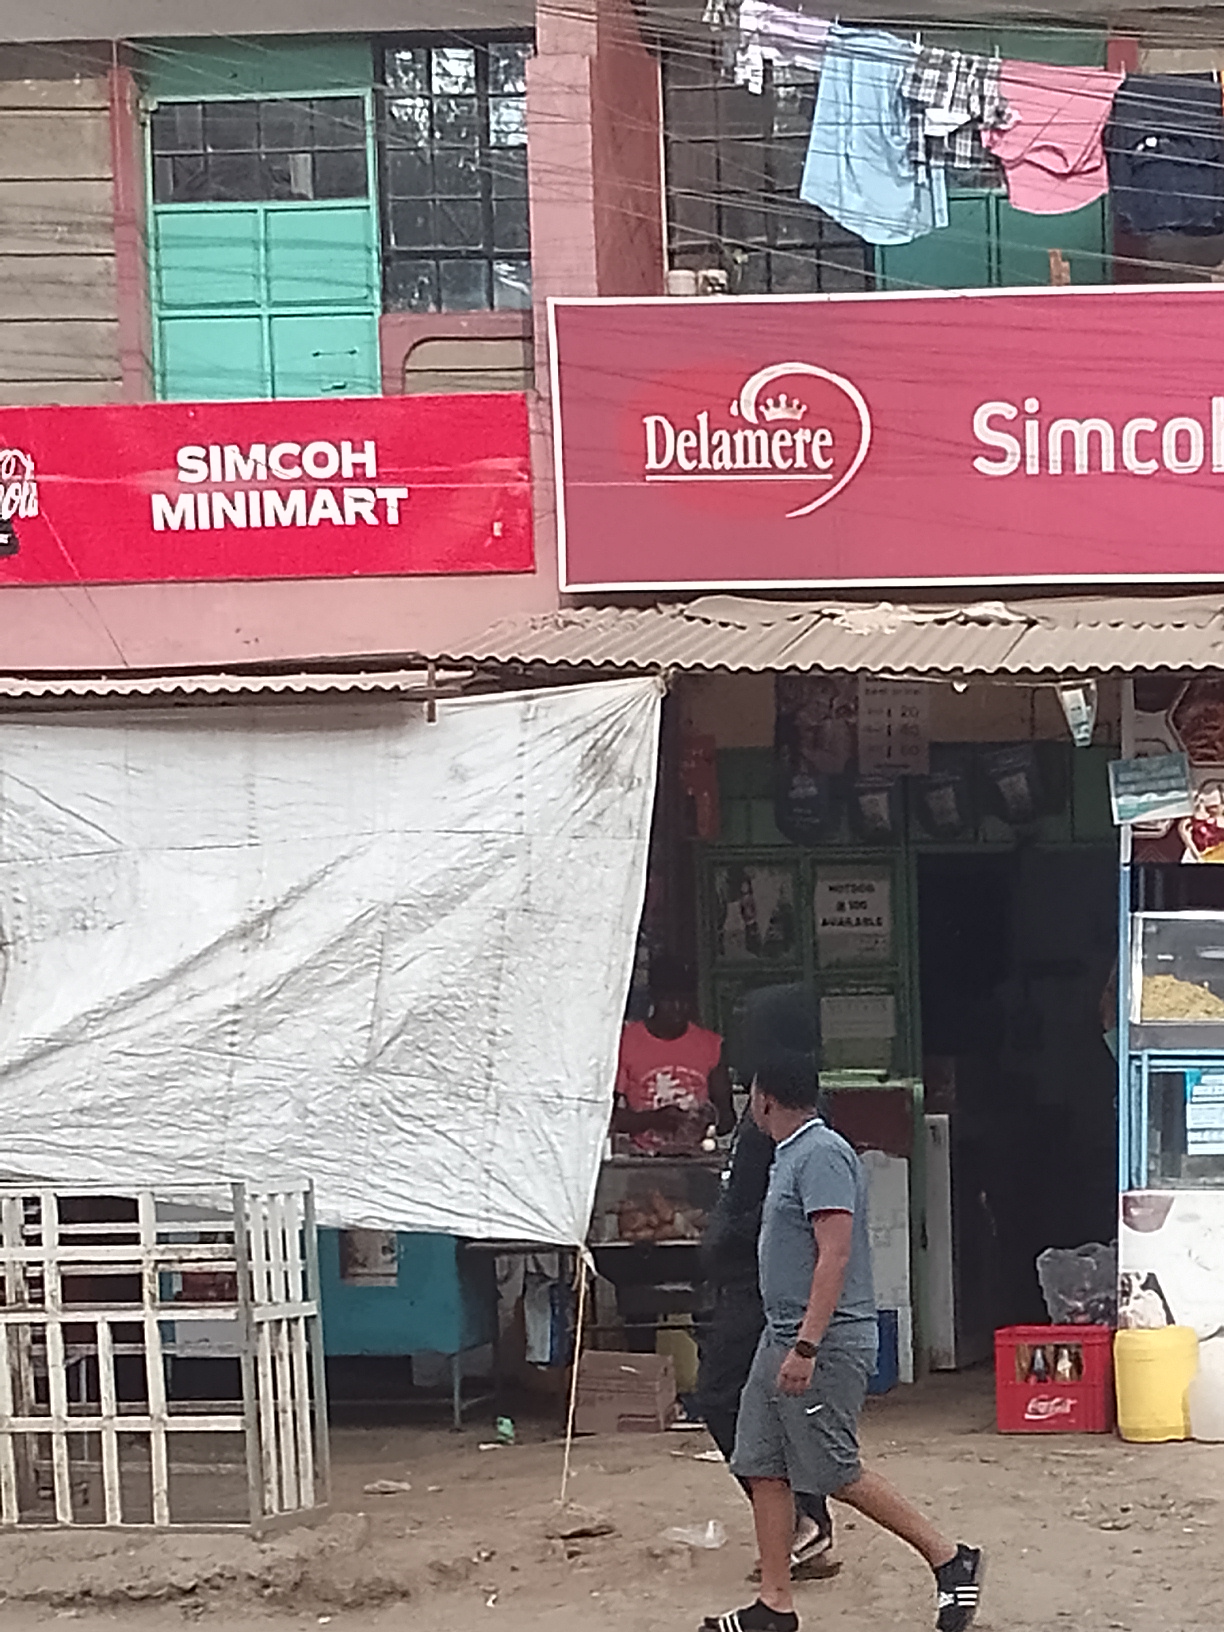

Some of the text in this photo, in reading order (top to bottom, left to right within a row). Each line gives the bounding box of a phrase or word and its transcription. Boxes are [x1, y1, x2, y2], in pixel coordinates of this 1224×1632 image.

[176, 441, 377, 483] SIMCOH
[642, 411, 834, 470] Delamere
[151, 487, 408, 531] MINIMART
